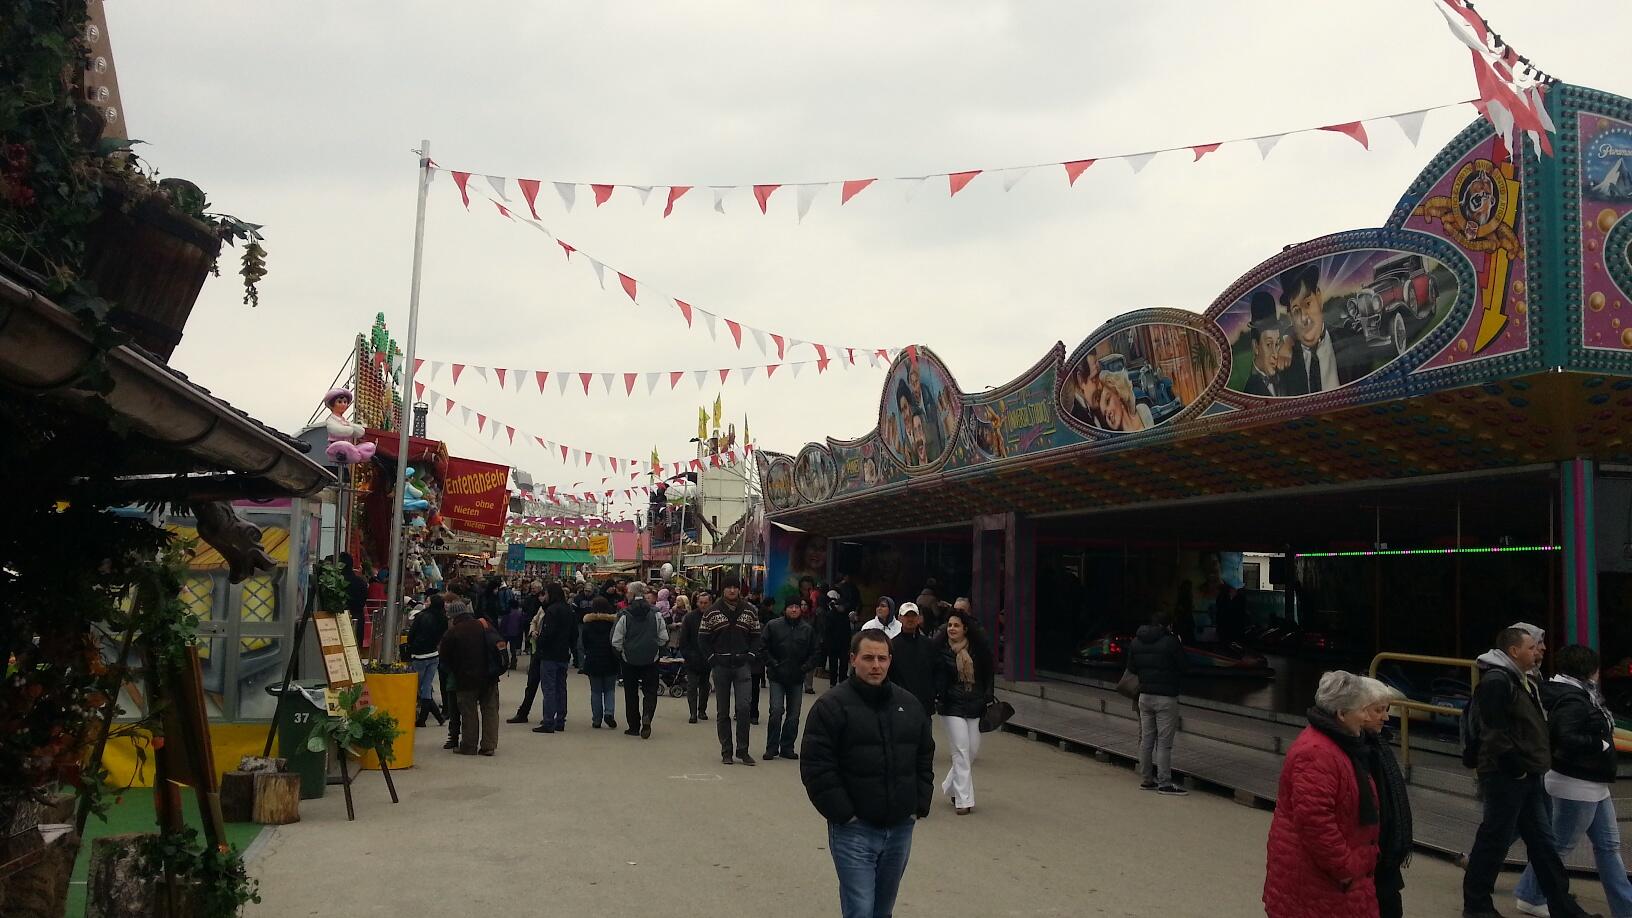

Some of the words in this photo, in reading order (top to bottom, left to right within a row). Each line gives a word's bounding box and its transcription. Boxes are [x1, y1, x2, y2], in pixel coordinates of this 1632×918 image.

[446, 469, 506, 495] Entenangeln
[453, 505, 480, 517] Nieten
[475, 500, 494, 510] ohne
[294, 712, 310, 724] 37
